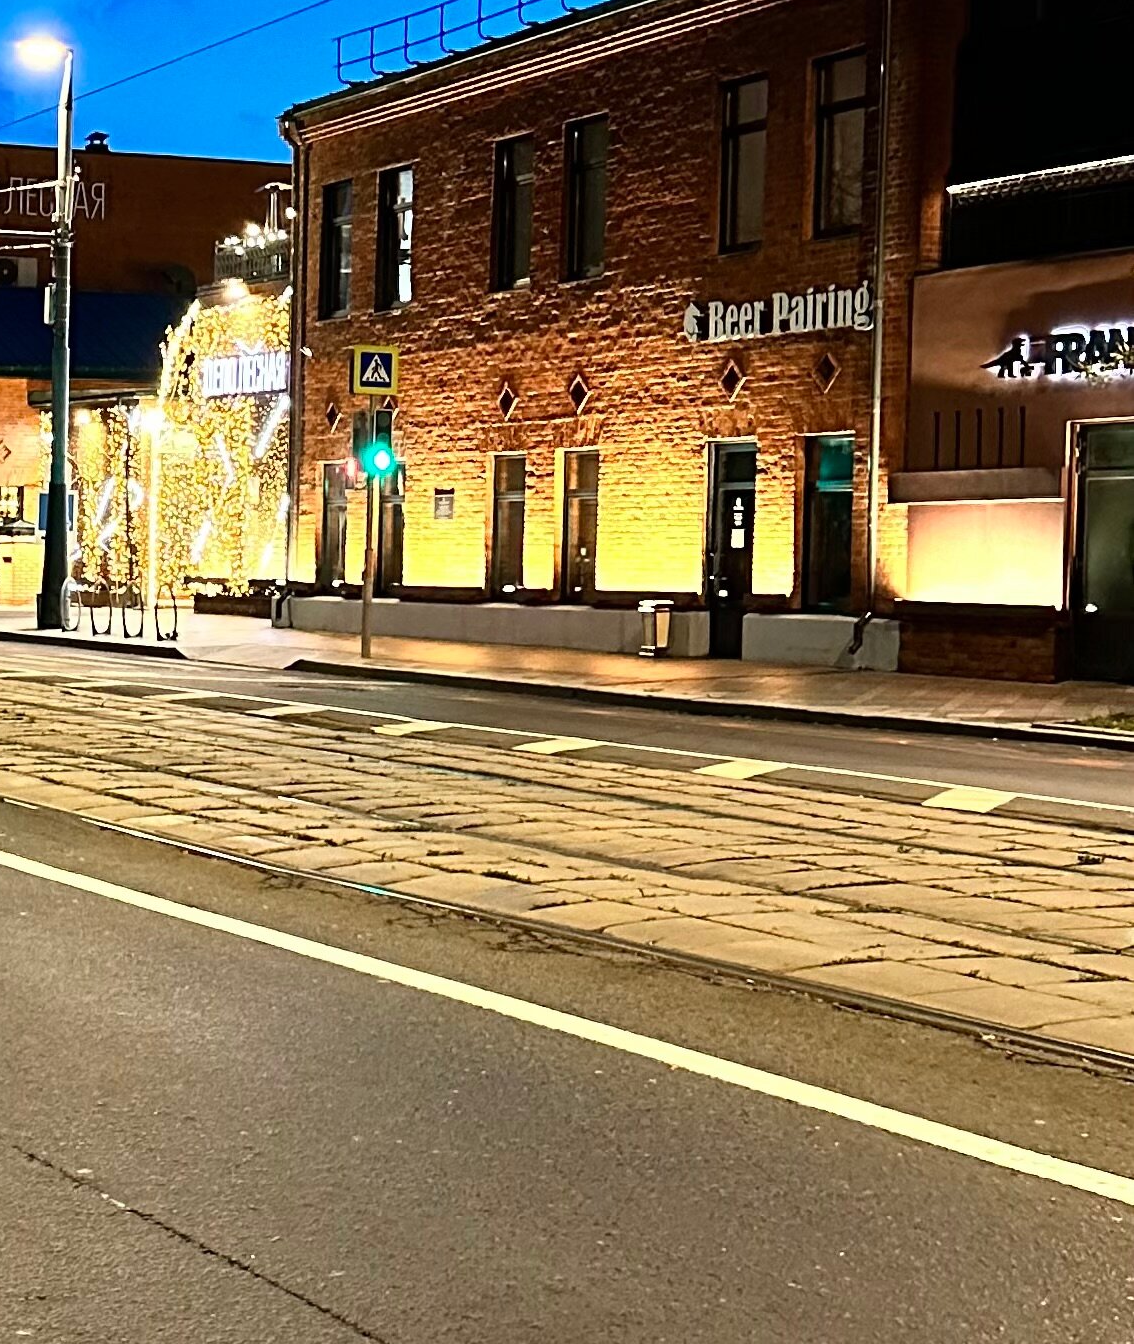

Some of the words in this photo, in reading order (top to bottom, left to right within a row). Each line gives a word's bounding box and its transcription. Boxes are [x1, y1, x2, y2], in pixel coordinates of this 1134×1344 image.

[4, 176, 106, 221] ЛЕСАЯ
[708, 300, 765, 340] Beer
[772, 280, 874, 334] Pairing
